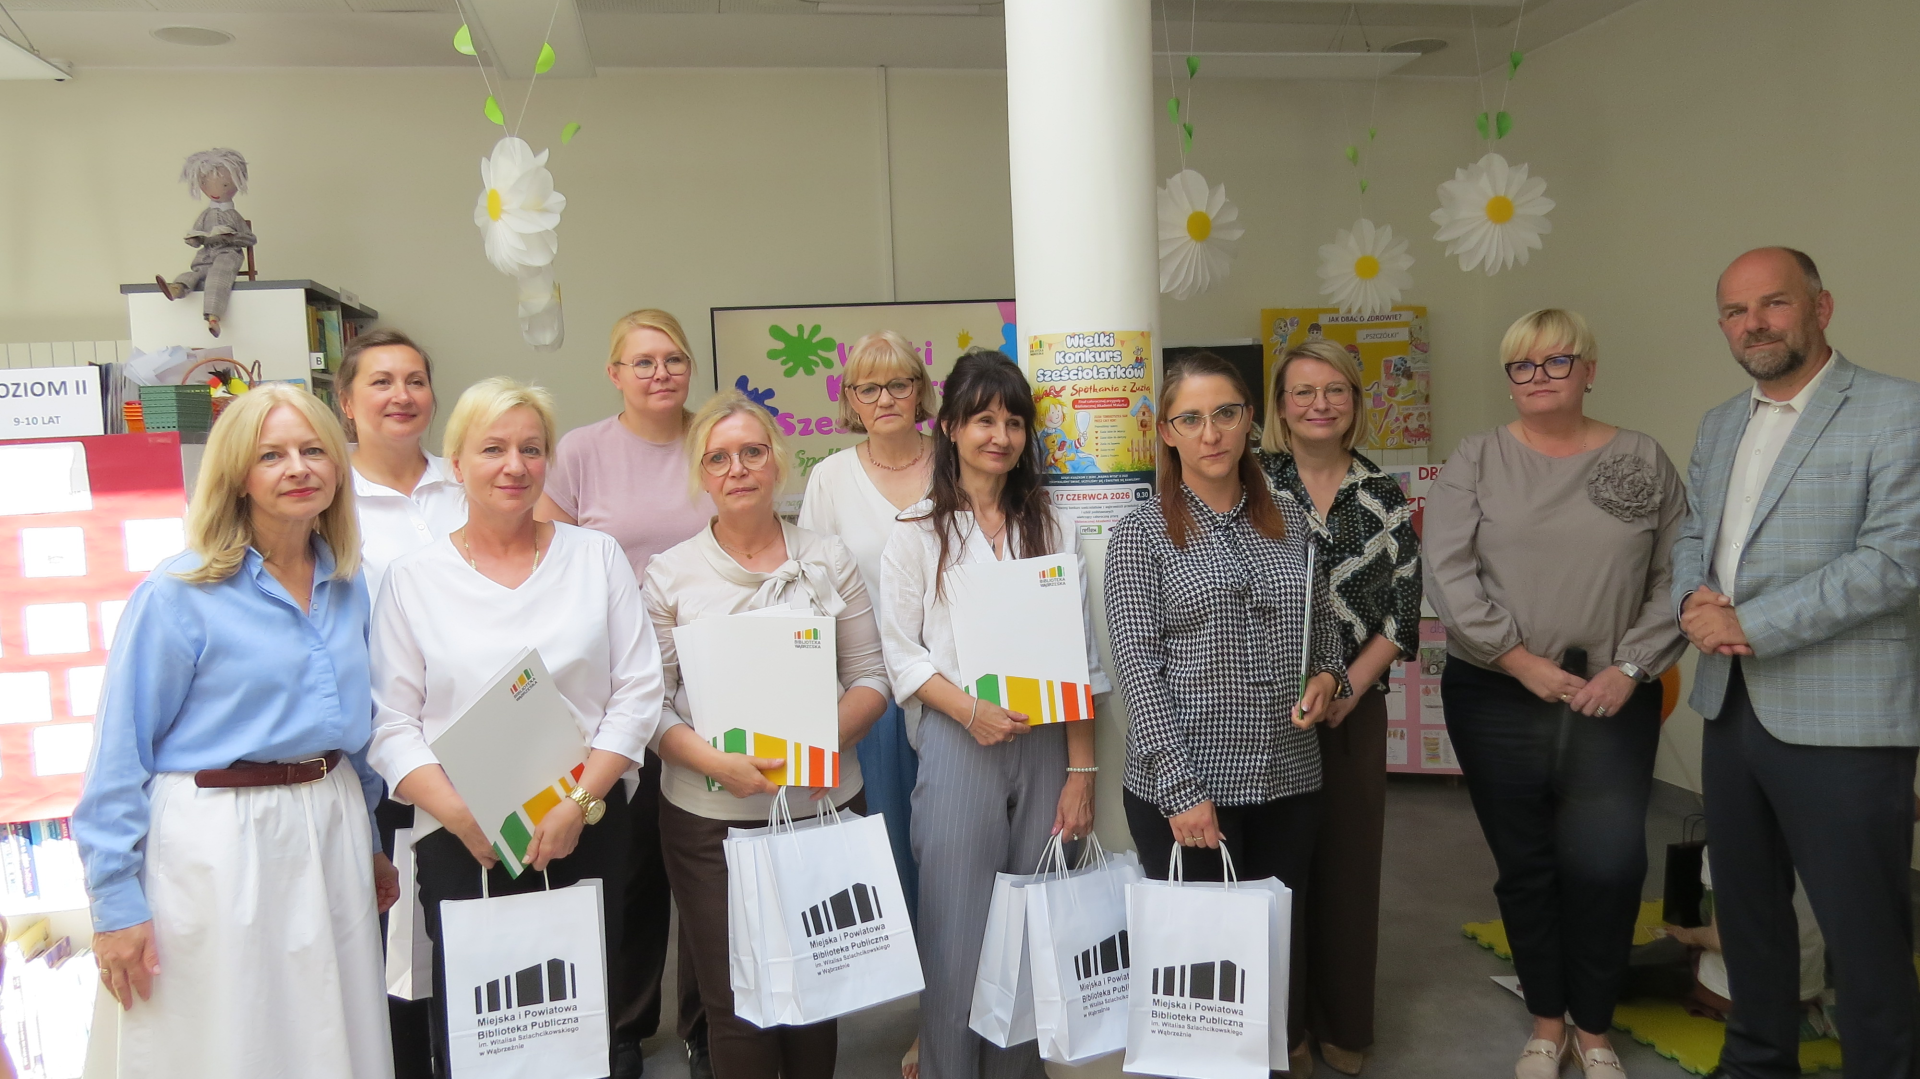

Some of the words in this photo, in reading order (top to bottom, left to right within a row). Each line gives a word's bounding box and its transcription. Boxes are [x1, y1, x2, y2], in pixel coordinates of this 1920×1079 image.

[1066, 332, 1114, 348] Wielki
[316, 357, 322, 365] B
[1055, 349, 1121, 365] Konkurs
[1036, 365, 1144, 382] Sześciolatków
[75, 380, 87, 395] II
[1070, 384, 1119, 397] Spotkania
[1130, 382, 1151, 394] Zuzią
[14, 417, 38, 426] 9-10
[42, 416, 61, 424] LAT
[1066, 492, 1108, 501] CZERWCA
[1110, 491, 1130, 500] 2026
[810, 936, 838, 949] Miejska
[844, 923, 886, 940] Powiatowa
[813, 945, 849, 960] Biblioteka
[852, 934, 889, 949] Publiczna
[1079, 980, 1102, 992] Miejska
[1082, 989, 1111, 1003] Biblioteka
[478, 1012, 515, 1027] Miejska
[525, 1004, 578, 1018] Powiatowa
[1152, 999, 1186, 1010] Miejska
[1195, 1003, 1244, 1016] Powiatowa
[1152, 1011, 1196, 1022] Biblioteka
[1200, 1015, 1244, 1027] Publiczna
[478, 1024, 528, 1039] Biblioteka
[531, 1016, 578, 1029] Publiczna
[490, 1036, 516, 1046] Witalisa
